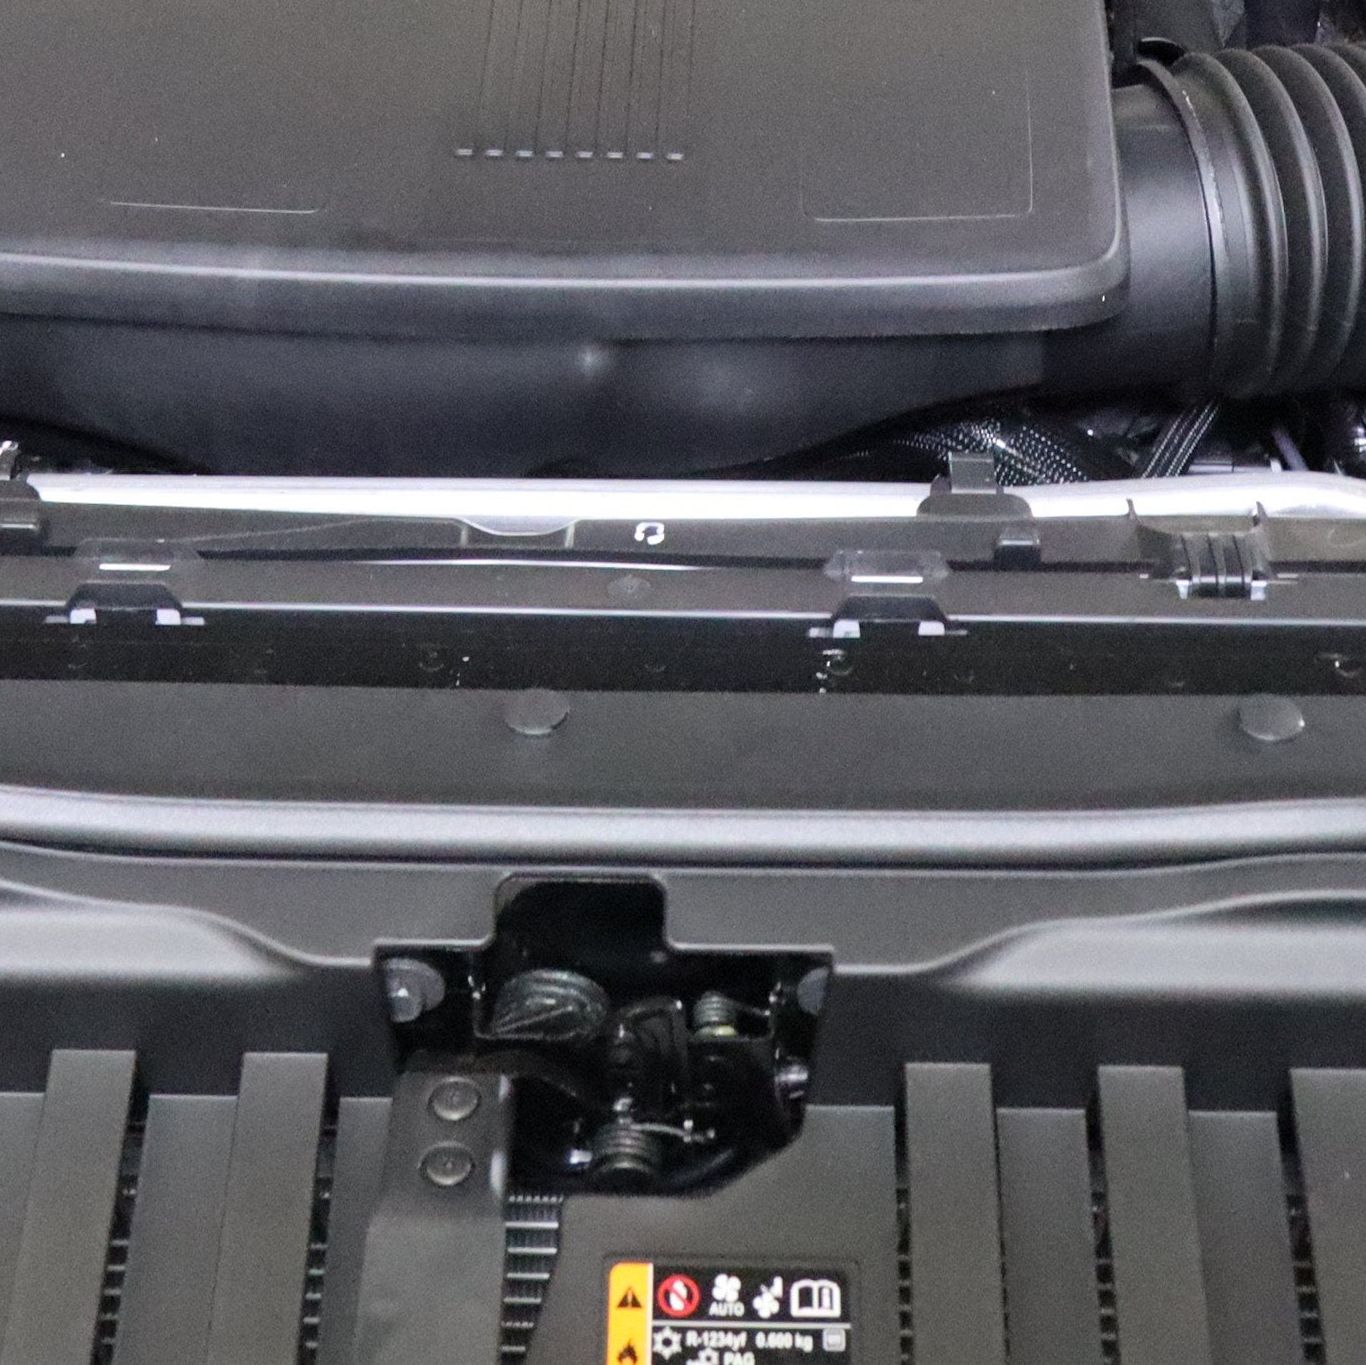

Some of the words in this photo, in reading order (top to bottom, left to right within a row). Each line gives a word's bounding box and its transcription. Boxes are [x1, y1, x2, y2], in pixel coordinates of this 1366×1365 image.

[709, 1301, 745, 1316] AUTO
[685, 1330, 747, 1351] R-1234yf
[794, 1331, 814, 1353] kg
